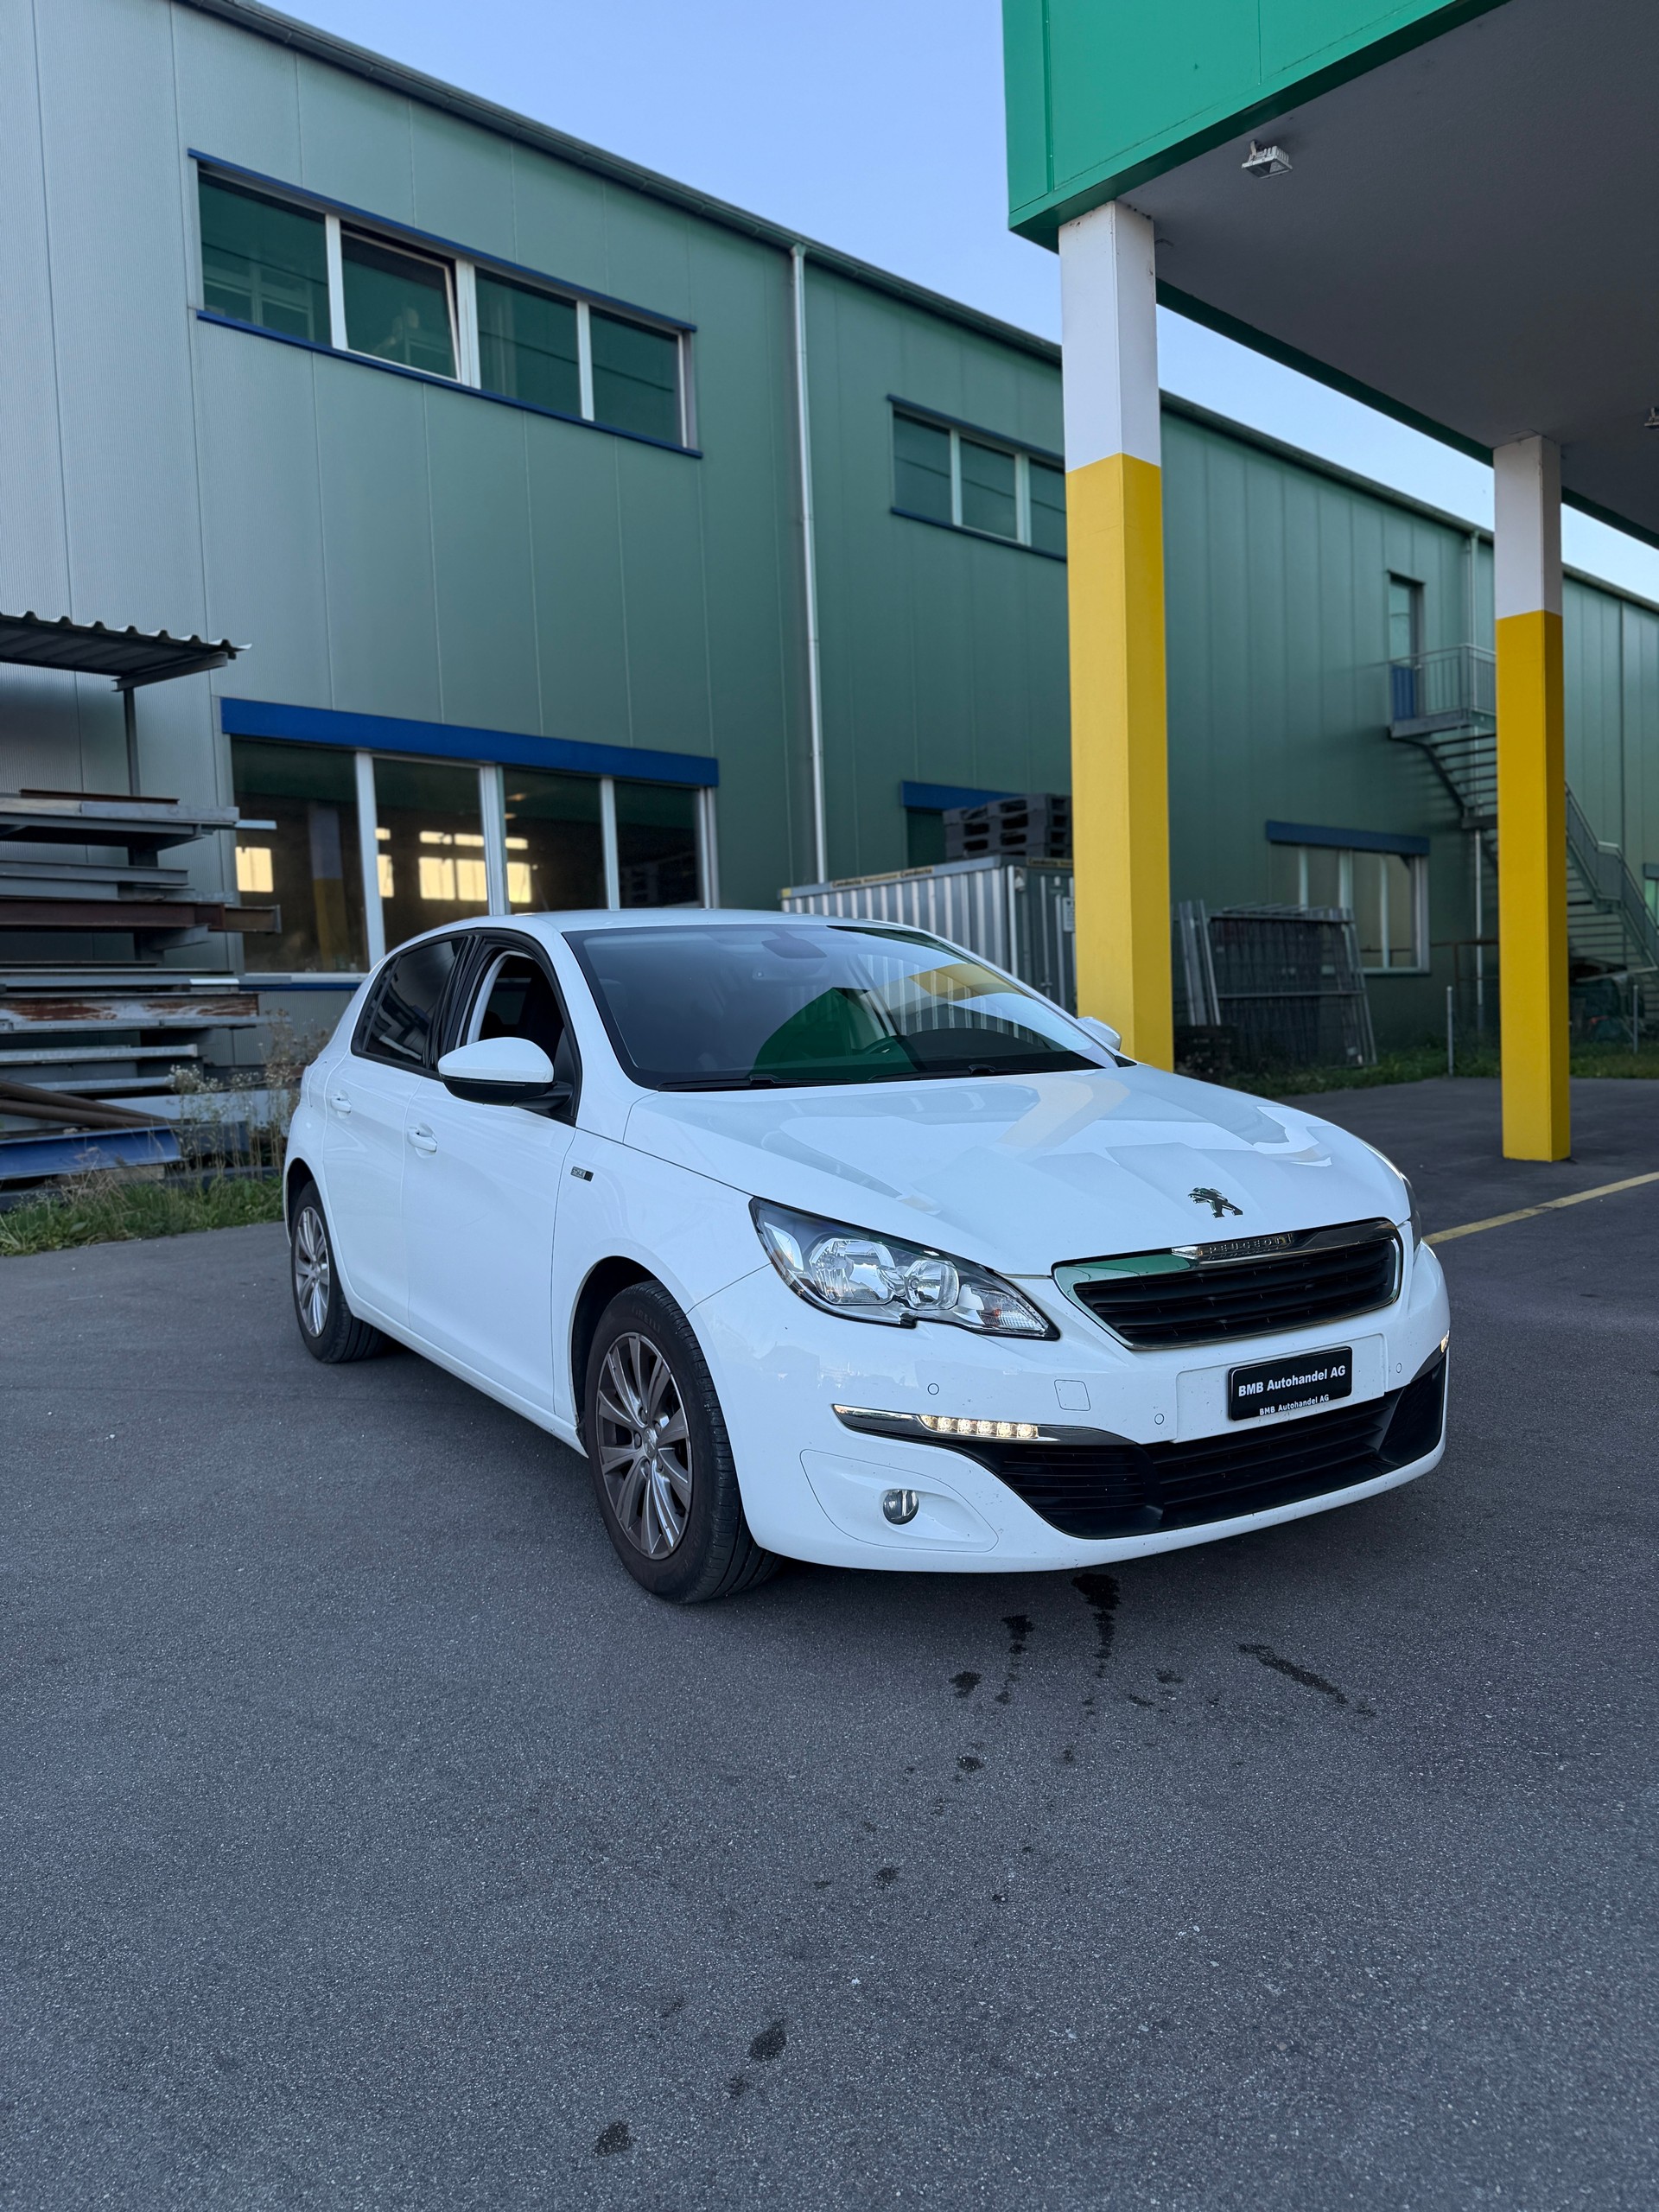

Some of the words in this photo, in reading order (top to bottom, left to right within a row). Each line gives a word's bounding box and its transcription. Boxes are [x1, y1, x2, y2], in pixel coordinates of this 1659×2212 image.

[1238, 1382, 1264, 1397] BMB
[1267, 1369, 1327, 1392] Autohandel
[1330, 1365, 1346, 1378] AG
[1259, 1406, 1275, 1416] BMB
[1278, 1396, 1319, 1413] Autohandel
[1319, 1394, 1330, 1402] AG
